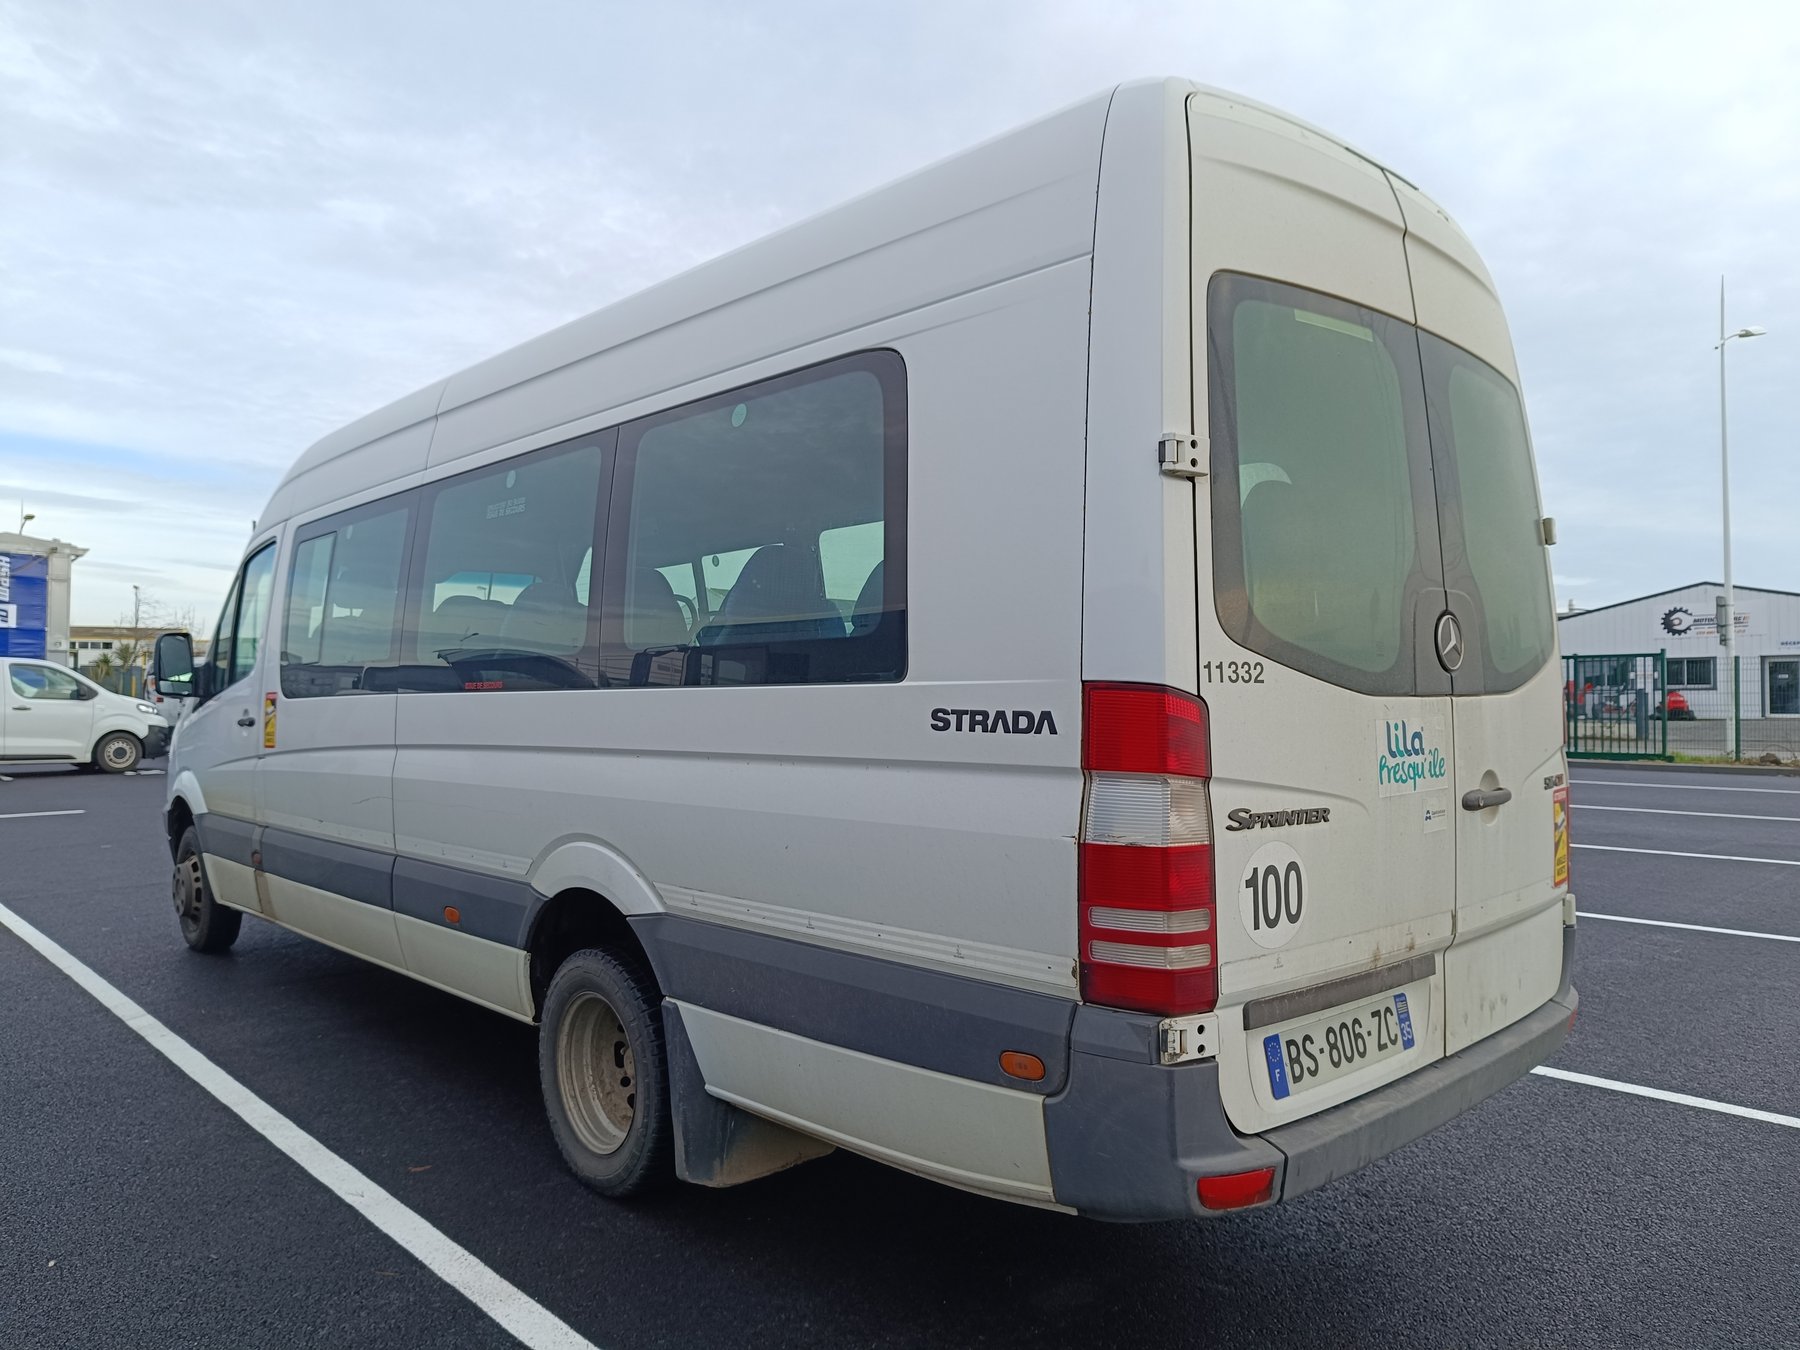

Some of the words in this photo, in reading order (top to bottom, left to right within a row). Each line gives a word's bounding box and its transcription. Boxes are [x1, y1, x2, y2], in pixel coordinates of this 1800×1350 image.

[1203, 661, 1264, 683] 11332
[930, 708, 1058, 735] STRADA
[1245, 861, 1302, 930] 100
[1275, 1069, 1281, 1082] F
[1286, 1006, 1398, 1084] BS-806-ZC
[1401, 1021, 1413, 1041] 35
